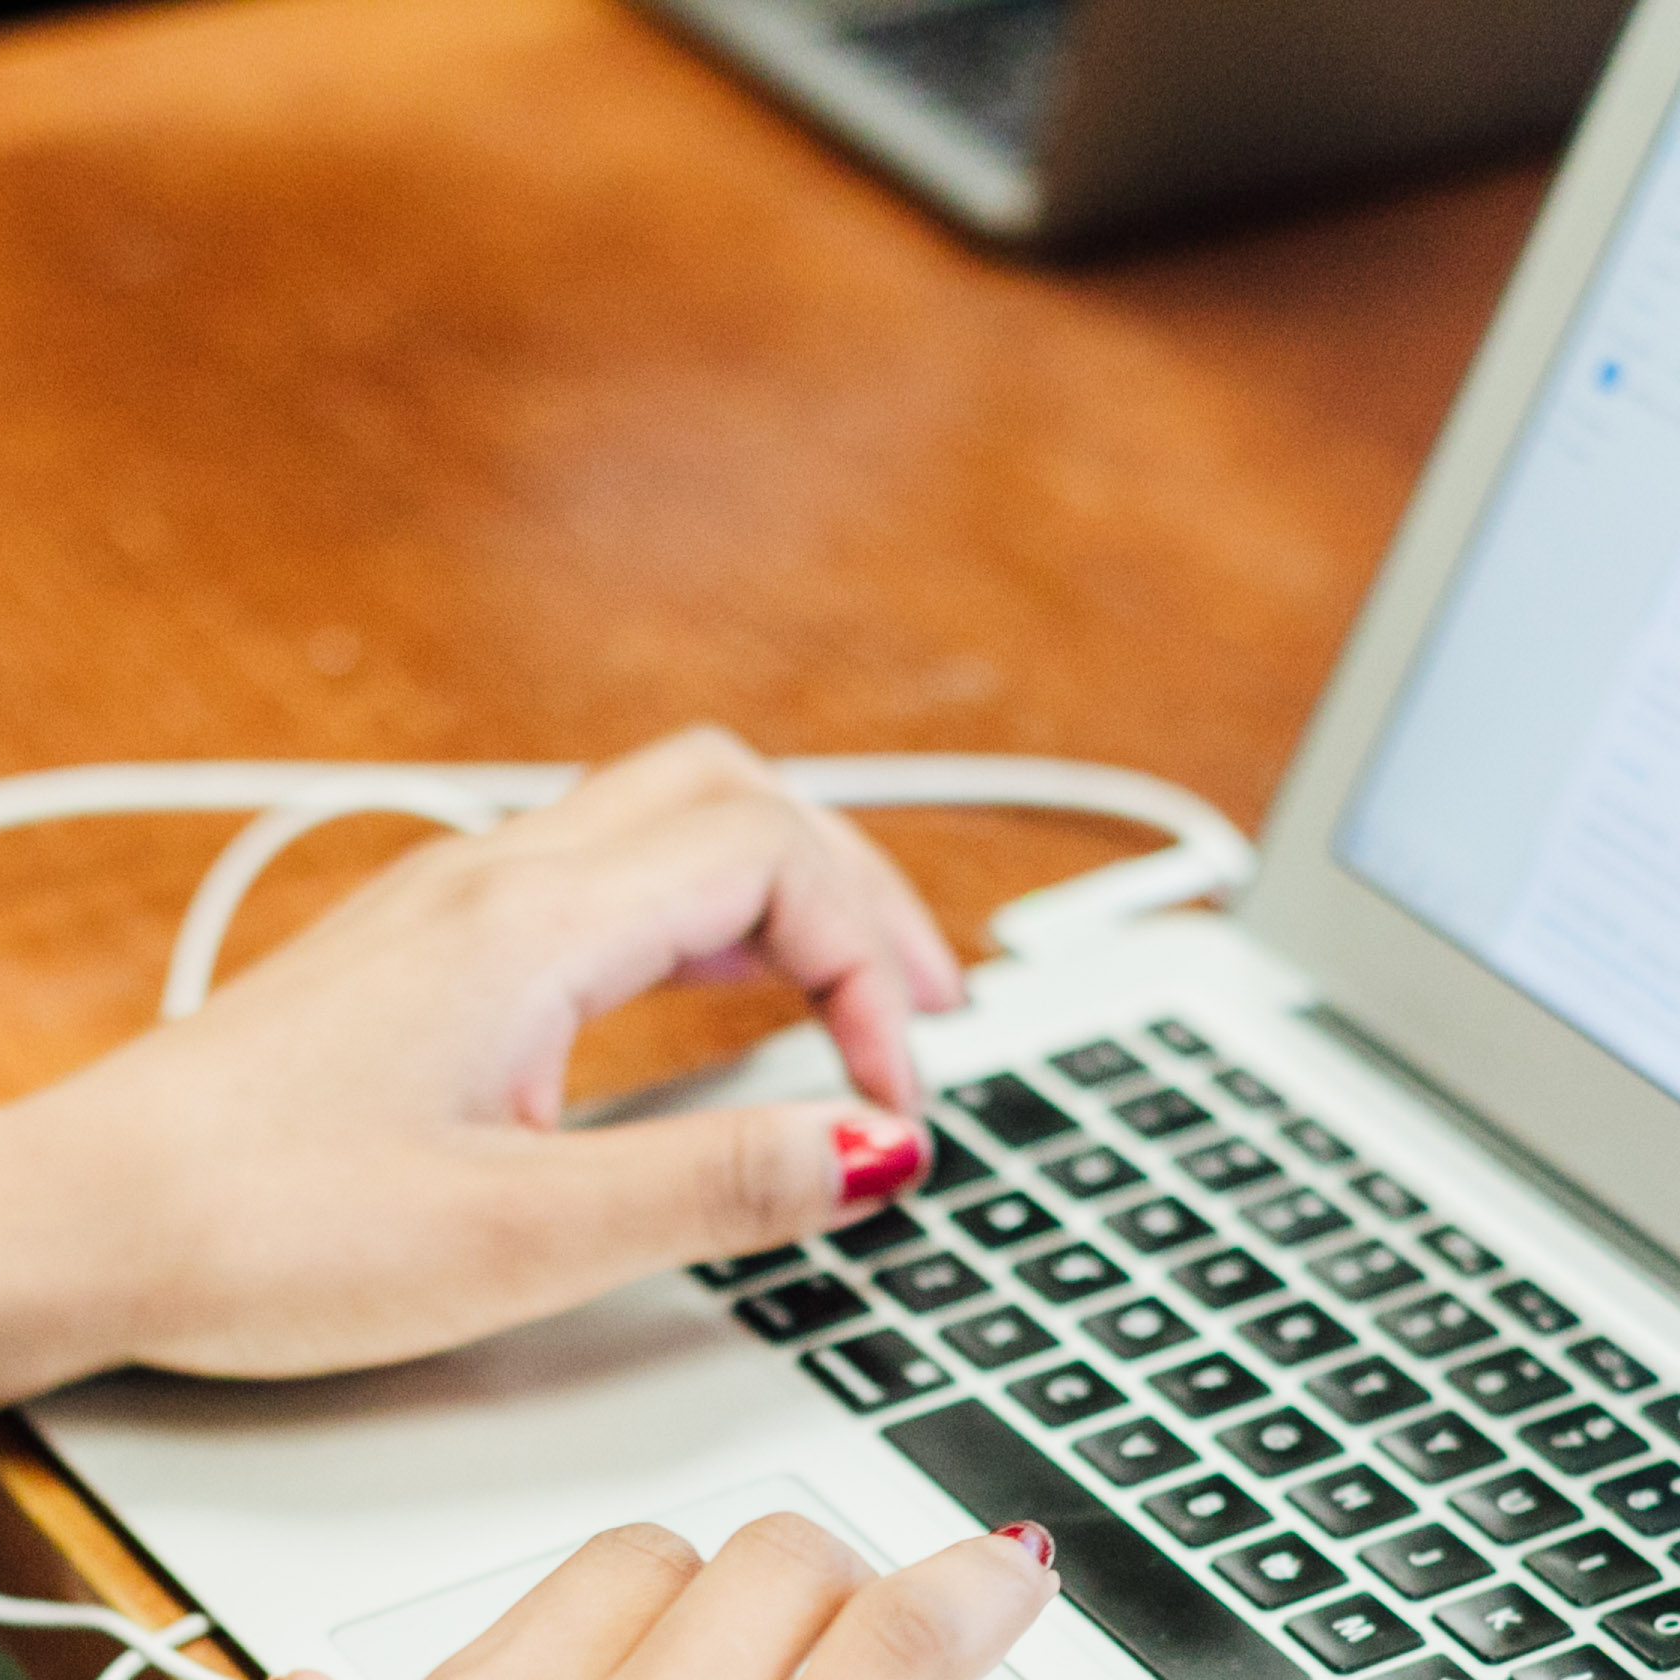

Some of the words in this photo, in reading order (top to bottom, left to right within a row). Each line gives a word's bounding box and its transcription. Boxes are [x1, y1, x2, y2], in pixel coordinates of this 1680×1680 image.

[1497, 1488, 1537, 1514] U
[1408, 1549, 1445, 1567] J
[1577, 1554, 1607, 1571] I
[1332, 1614, 1376, 1643] M
[1485, 1606, 1523, 1631] K
